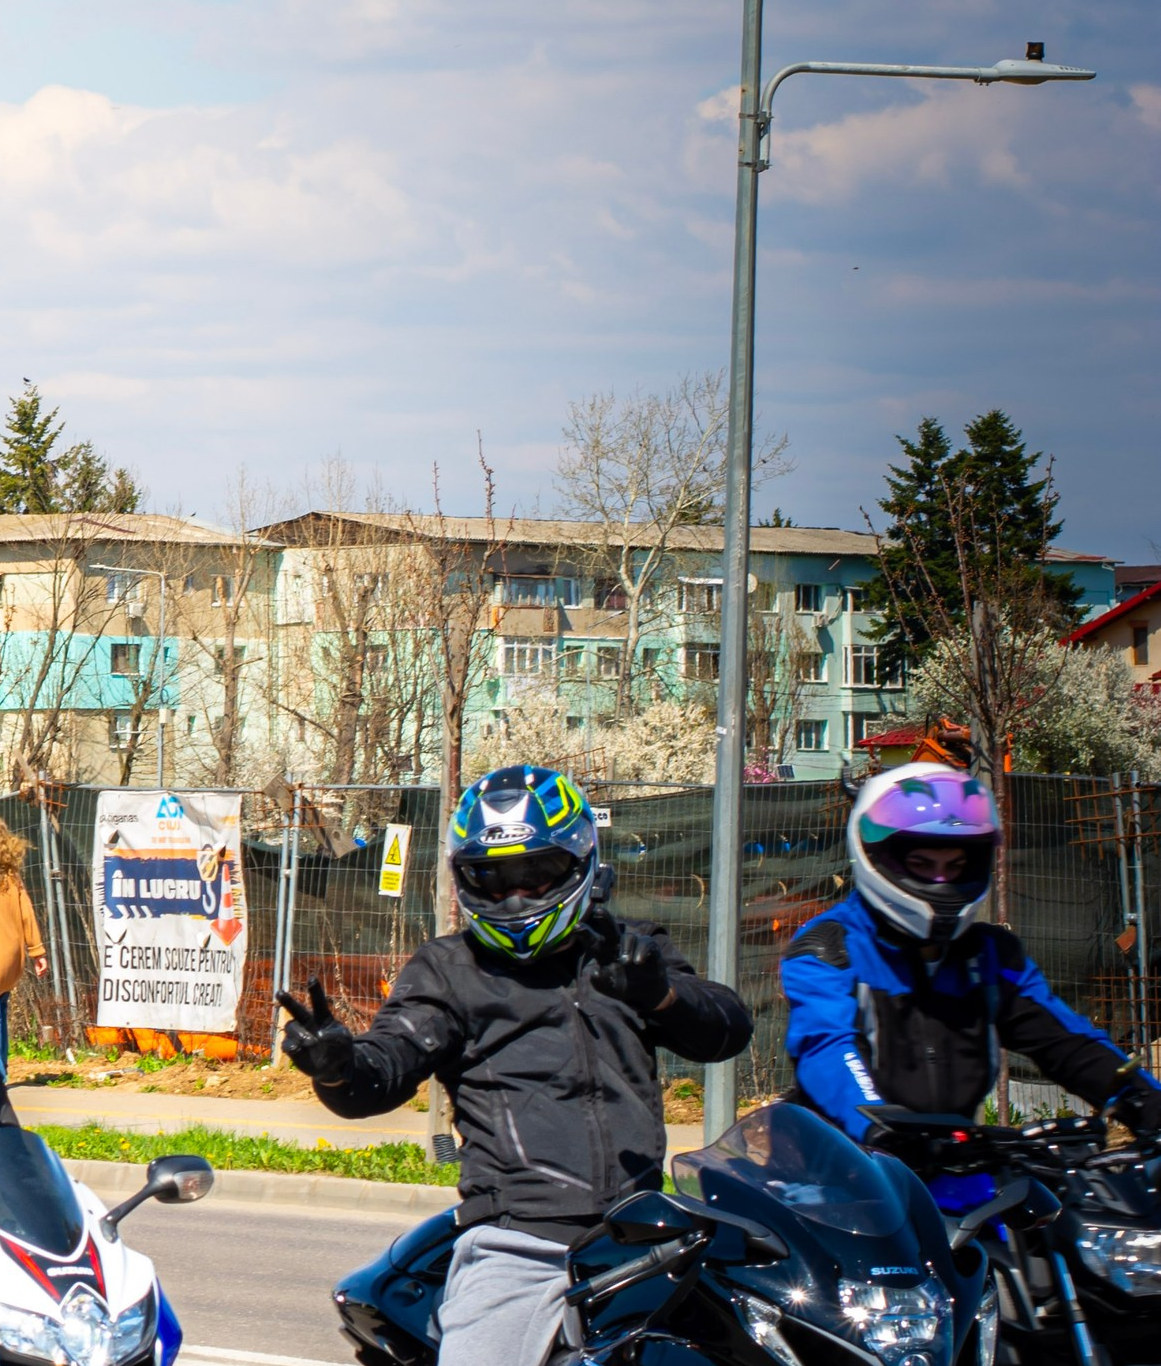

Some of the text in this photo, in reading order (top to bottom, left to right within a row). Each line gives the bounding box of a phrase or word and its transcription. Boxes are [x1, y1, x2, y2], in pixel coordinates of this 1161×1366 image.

[111, 869, 202, 901] ÎN LUCRU
[120, 945, 162, 970] CEREM
[164, 947, 196, 972] SCUZE
[197, 947, 232, 974] PENTRU
[103, 978, 190, 1005] DISCONFORTUL
[870, 1266, 919, 1276] SUZUKI
